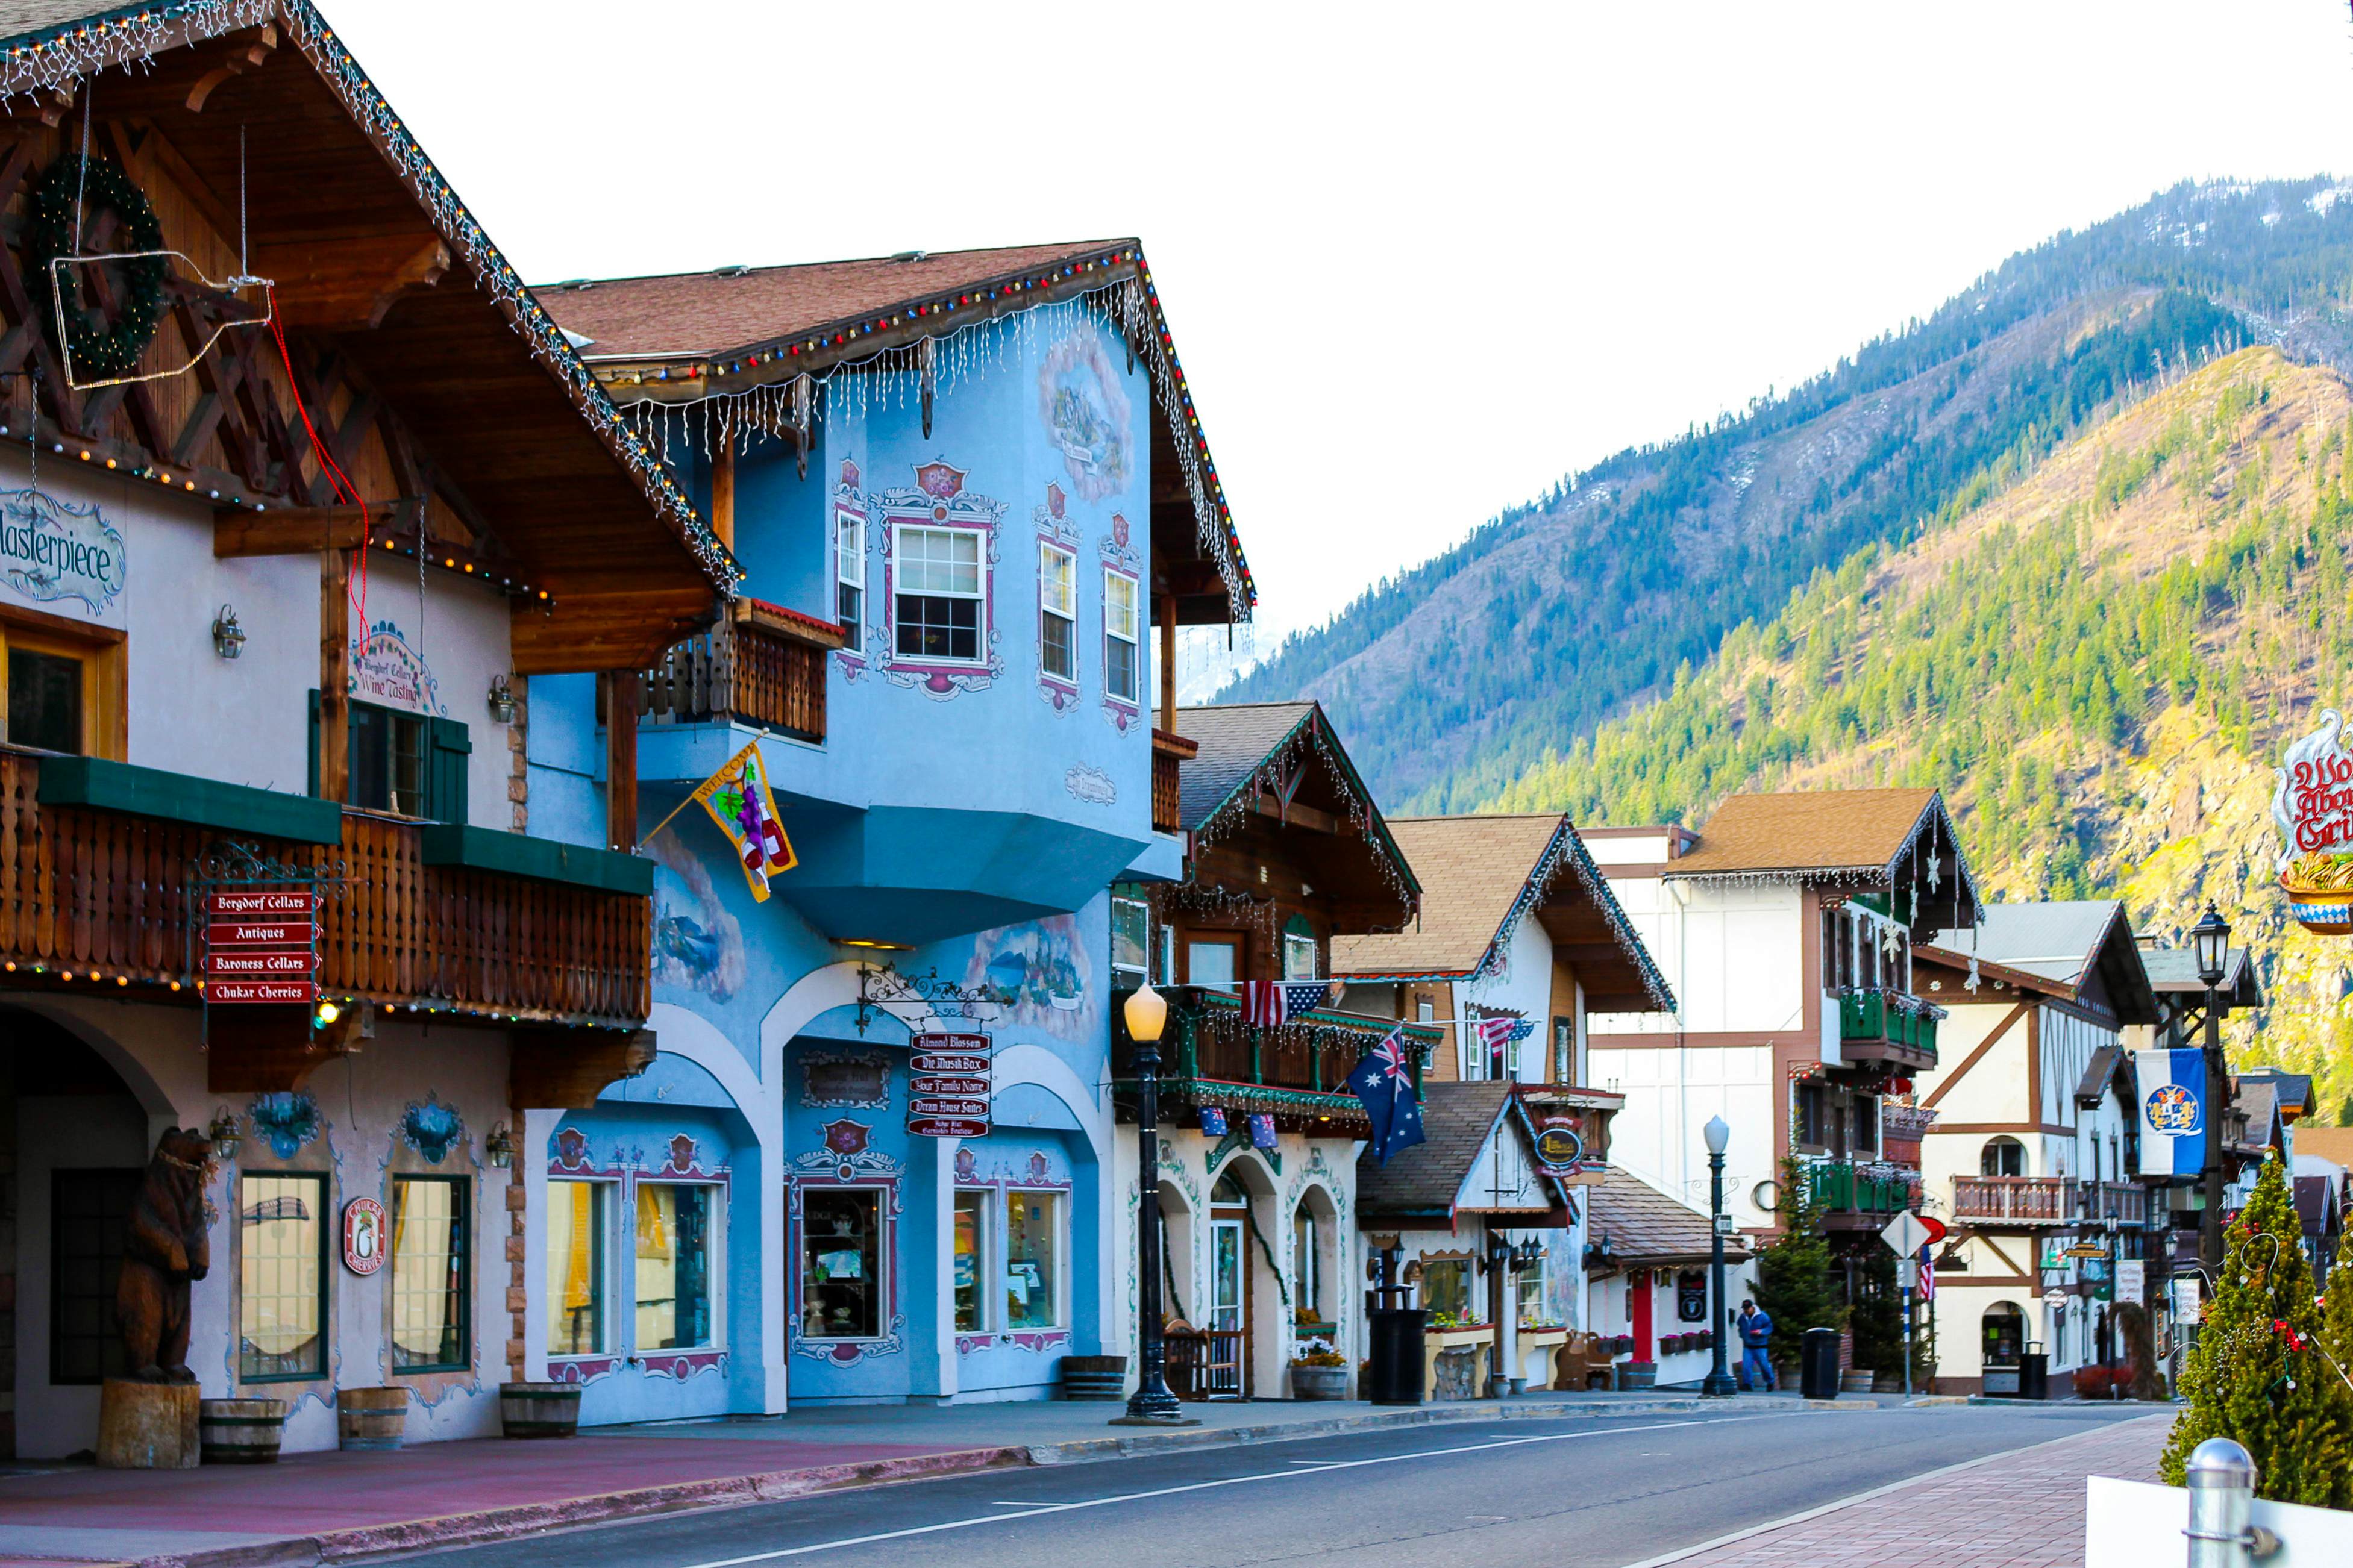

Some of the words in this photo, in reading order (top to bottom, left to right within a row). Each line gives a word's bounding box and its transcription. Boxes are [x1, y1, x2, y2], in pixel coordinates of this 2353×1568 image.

[360, 672, 384, 696] Wine
[386, 678, 418, 709] Tasting
[698, 742, 755, 796] WELCOME
[2294, 749, 2353, 792] Wo
[218, 896, 266, 912] Bergdorf
[268, 896, 304, 908] Cellars
[236, 926, 285, 941] Antiques
[216, 957, 264, 970] Baroness
[267, 956, 304, 969] Cellars
[216, 985, 254, 999] Chukar
[258, 985, 302, 999] Cherries
[920, 1035, 948, 1048] Almond
[950, 1035, 982, 1048] Blossom
[922, 1056, 935, 1069] Die
[936, 1057, 962, 1069] Musik
[963, 1057, 981, 1069] Box
[915, 1079, 933, 1091] Your
[933, 1079, 960, 1092] Family
[962, 1080, 983, 1092] Name
[916, 1100, 938, 1111] Dream
[939, 1101, 960, 1113] House
[961, 1101, 983, 1113] Suites
[349, 1199, 383, 1220] CHUKAR
[348, 1251, 383, 1272] CHERRIES
